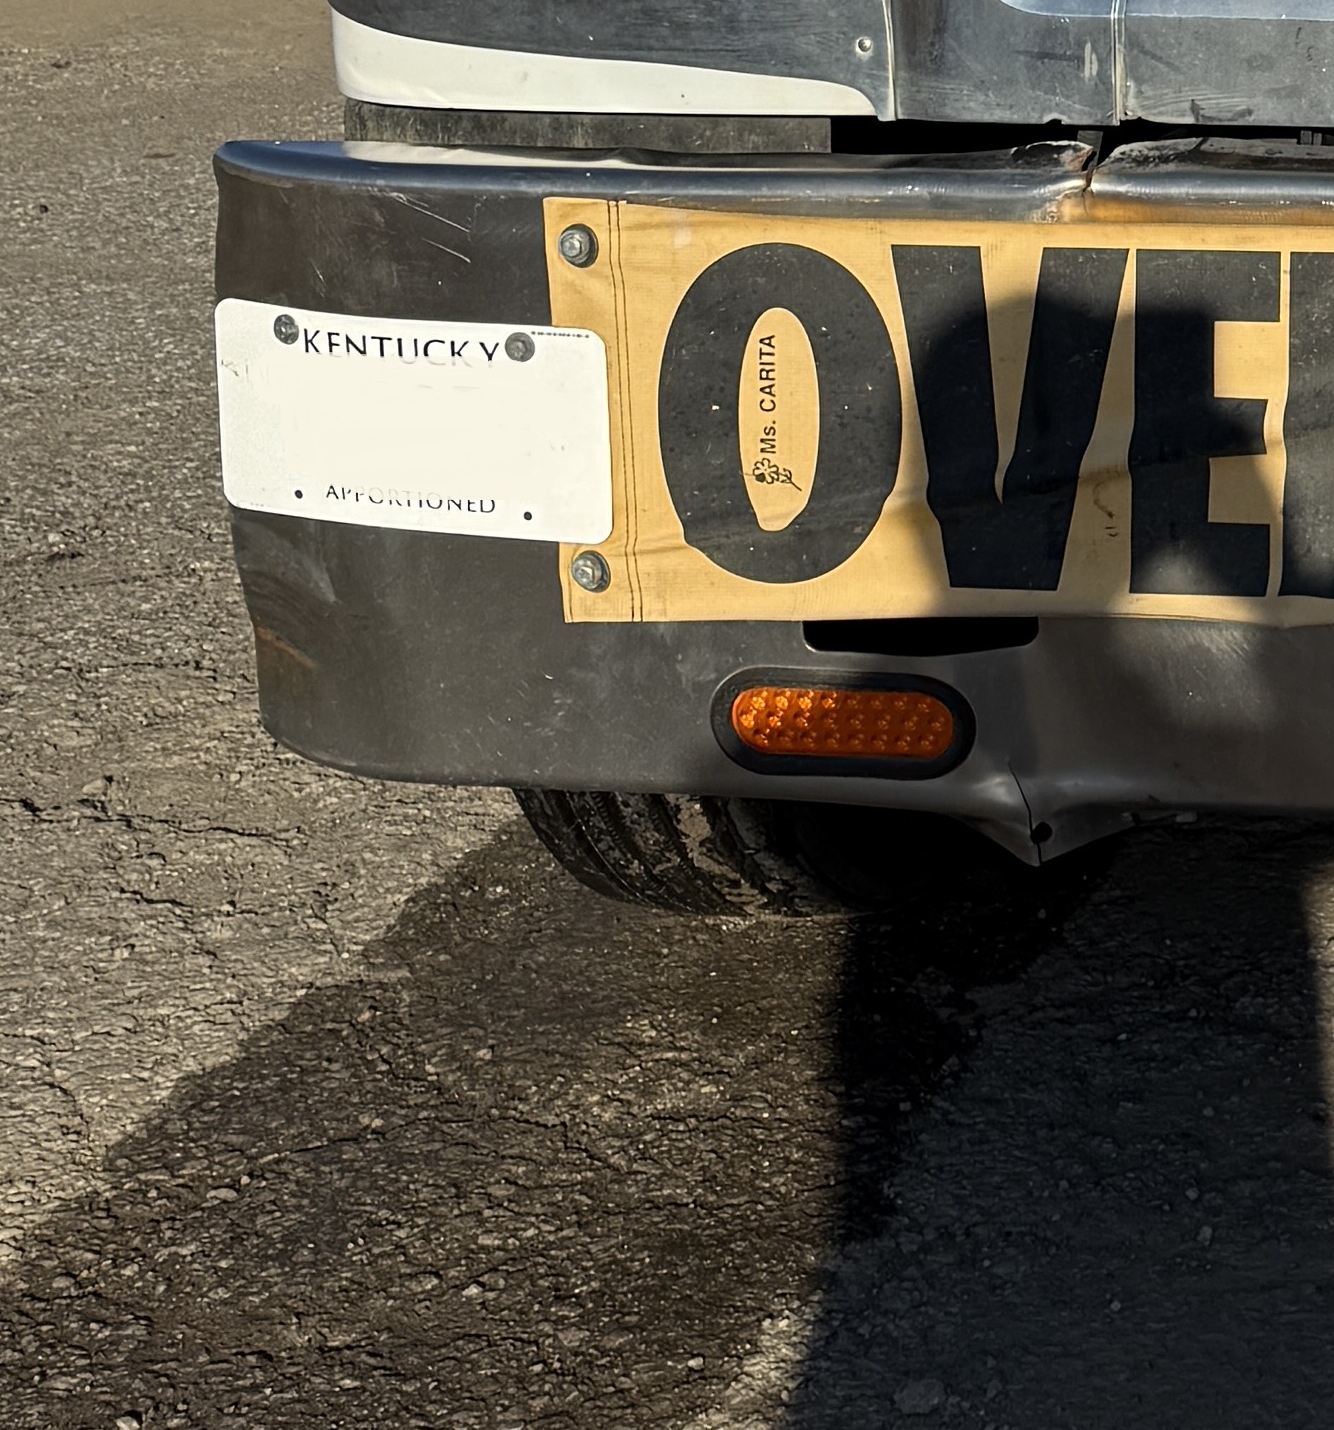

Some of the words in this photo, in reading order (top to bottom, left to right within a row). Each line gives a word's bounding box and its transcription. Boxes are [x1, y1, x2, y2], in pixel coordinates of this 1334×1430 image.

[303, 328, 499, 367] KENTUCKY
[759, 334, 776, 413] CARITA
[760, 419, 777, 454] Ms.
